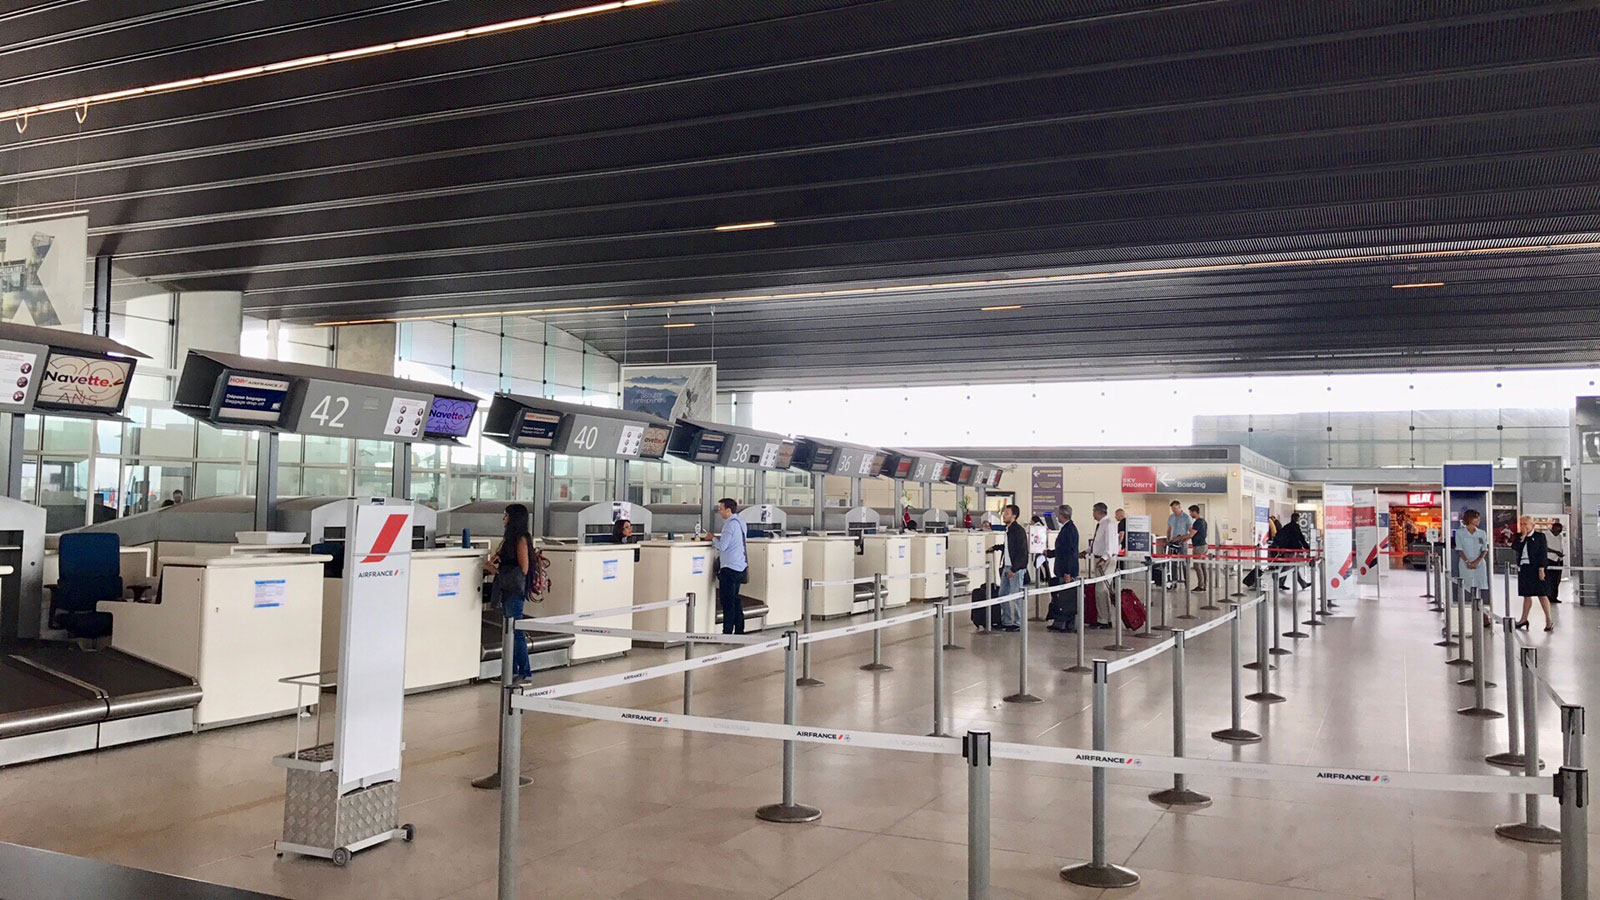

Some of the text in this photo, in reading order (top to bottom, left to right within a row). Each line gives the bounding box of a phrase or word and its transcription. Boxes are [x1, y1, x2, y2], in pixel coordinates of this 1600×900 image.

[310, 395, 350, 428] 42
[574, 425, 598, 450] 40
[732, 443, 750, 463] 38
[838, 455, 852, 472] 36
[915, 464, 927, 478] 34
[1177, 481, 1206, 489] Boarding
[359, 570, 393, 578] AIRFRANCE
[621, 713, 657, 721] AIRFRANCE
[797, 731, 837, 740] AIRFRANCE
[1075, 754, 1125, 764] AIRFRANCE
[1317, 772, 1371, 782] AIRFRANCE
